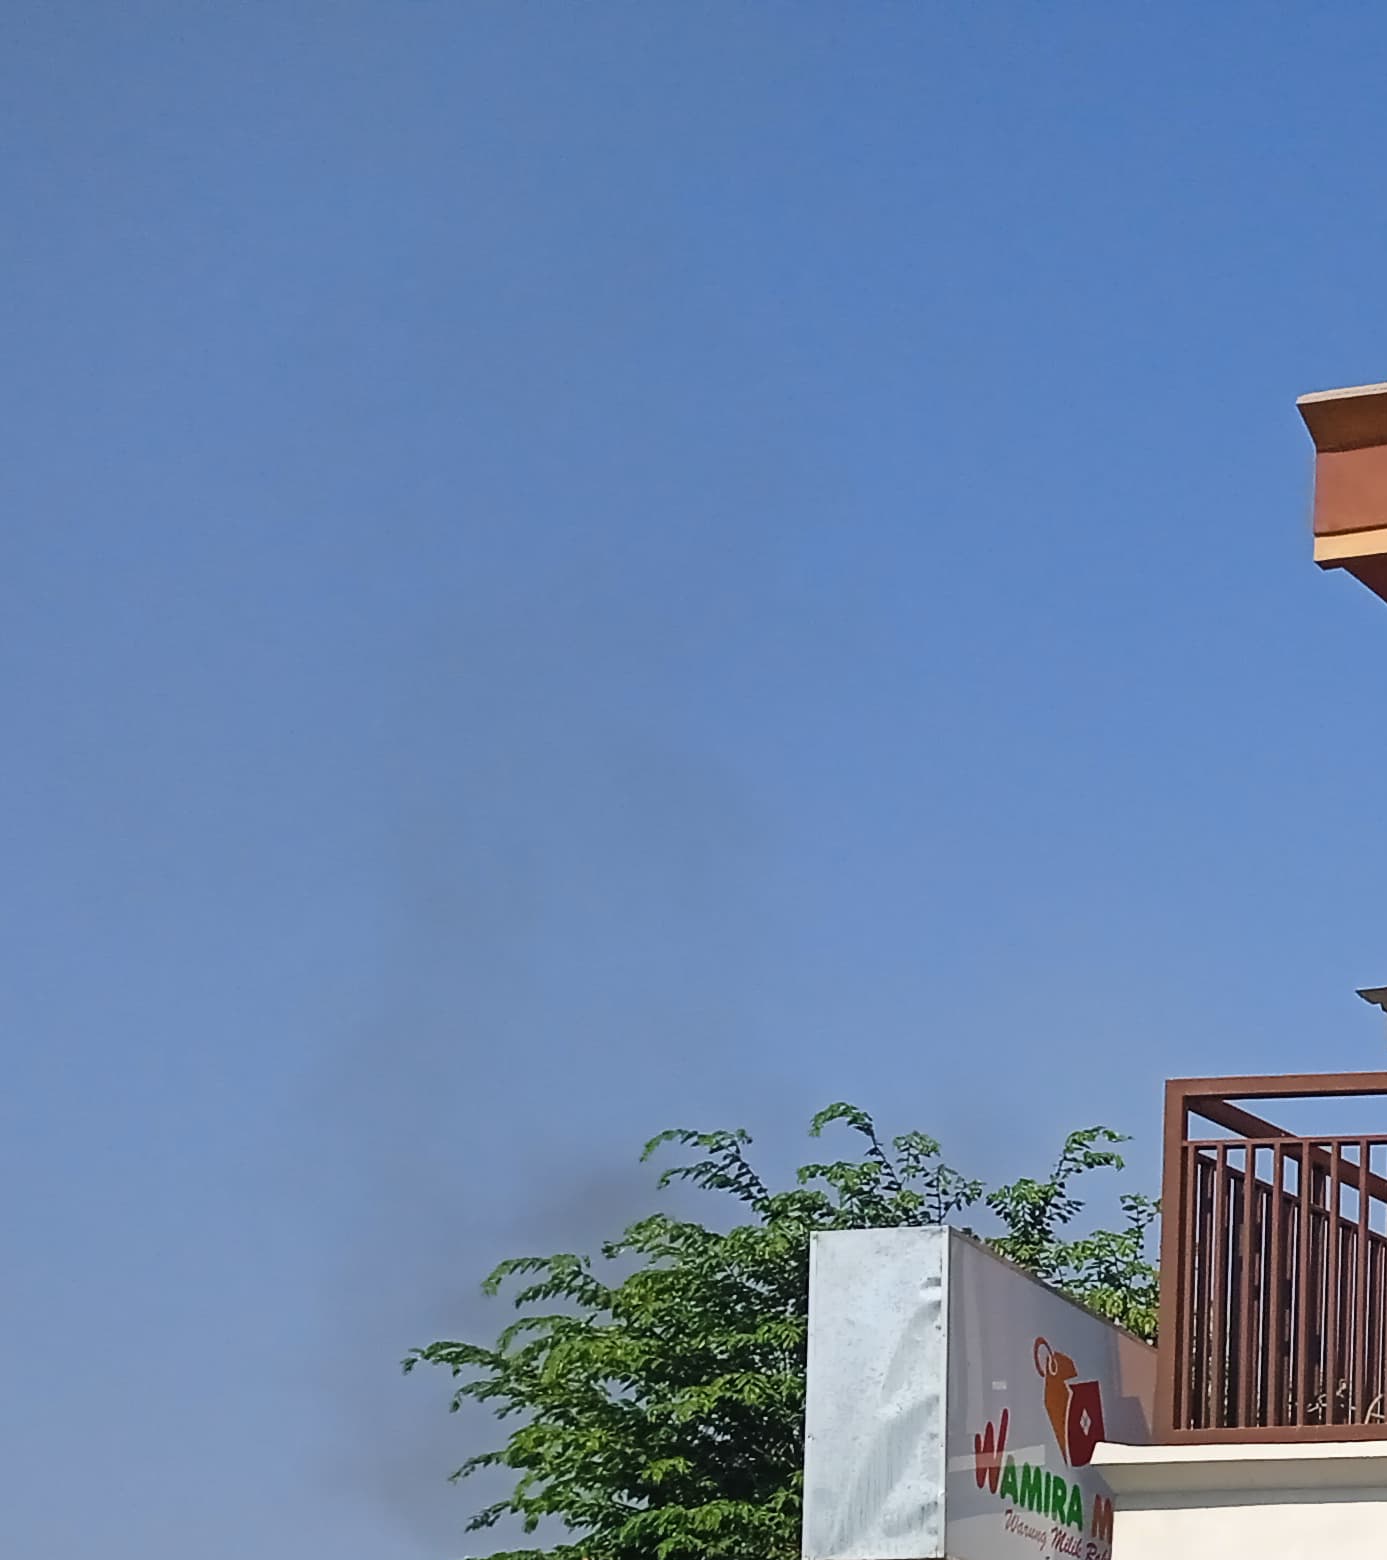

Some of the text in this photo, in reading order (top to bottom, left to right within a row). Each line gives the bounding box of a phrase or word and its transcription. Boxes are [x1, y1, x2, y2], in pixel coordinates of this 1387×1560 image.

[975, 1408, 1084, 1532] WAMIRA
[1004, 1508, 1048, 1552] Warung
[1051, 1526, 1083, 1560] Milik
